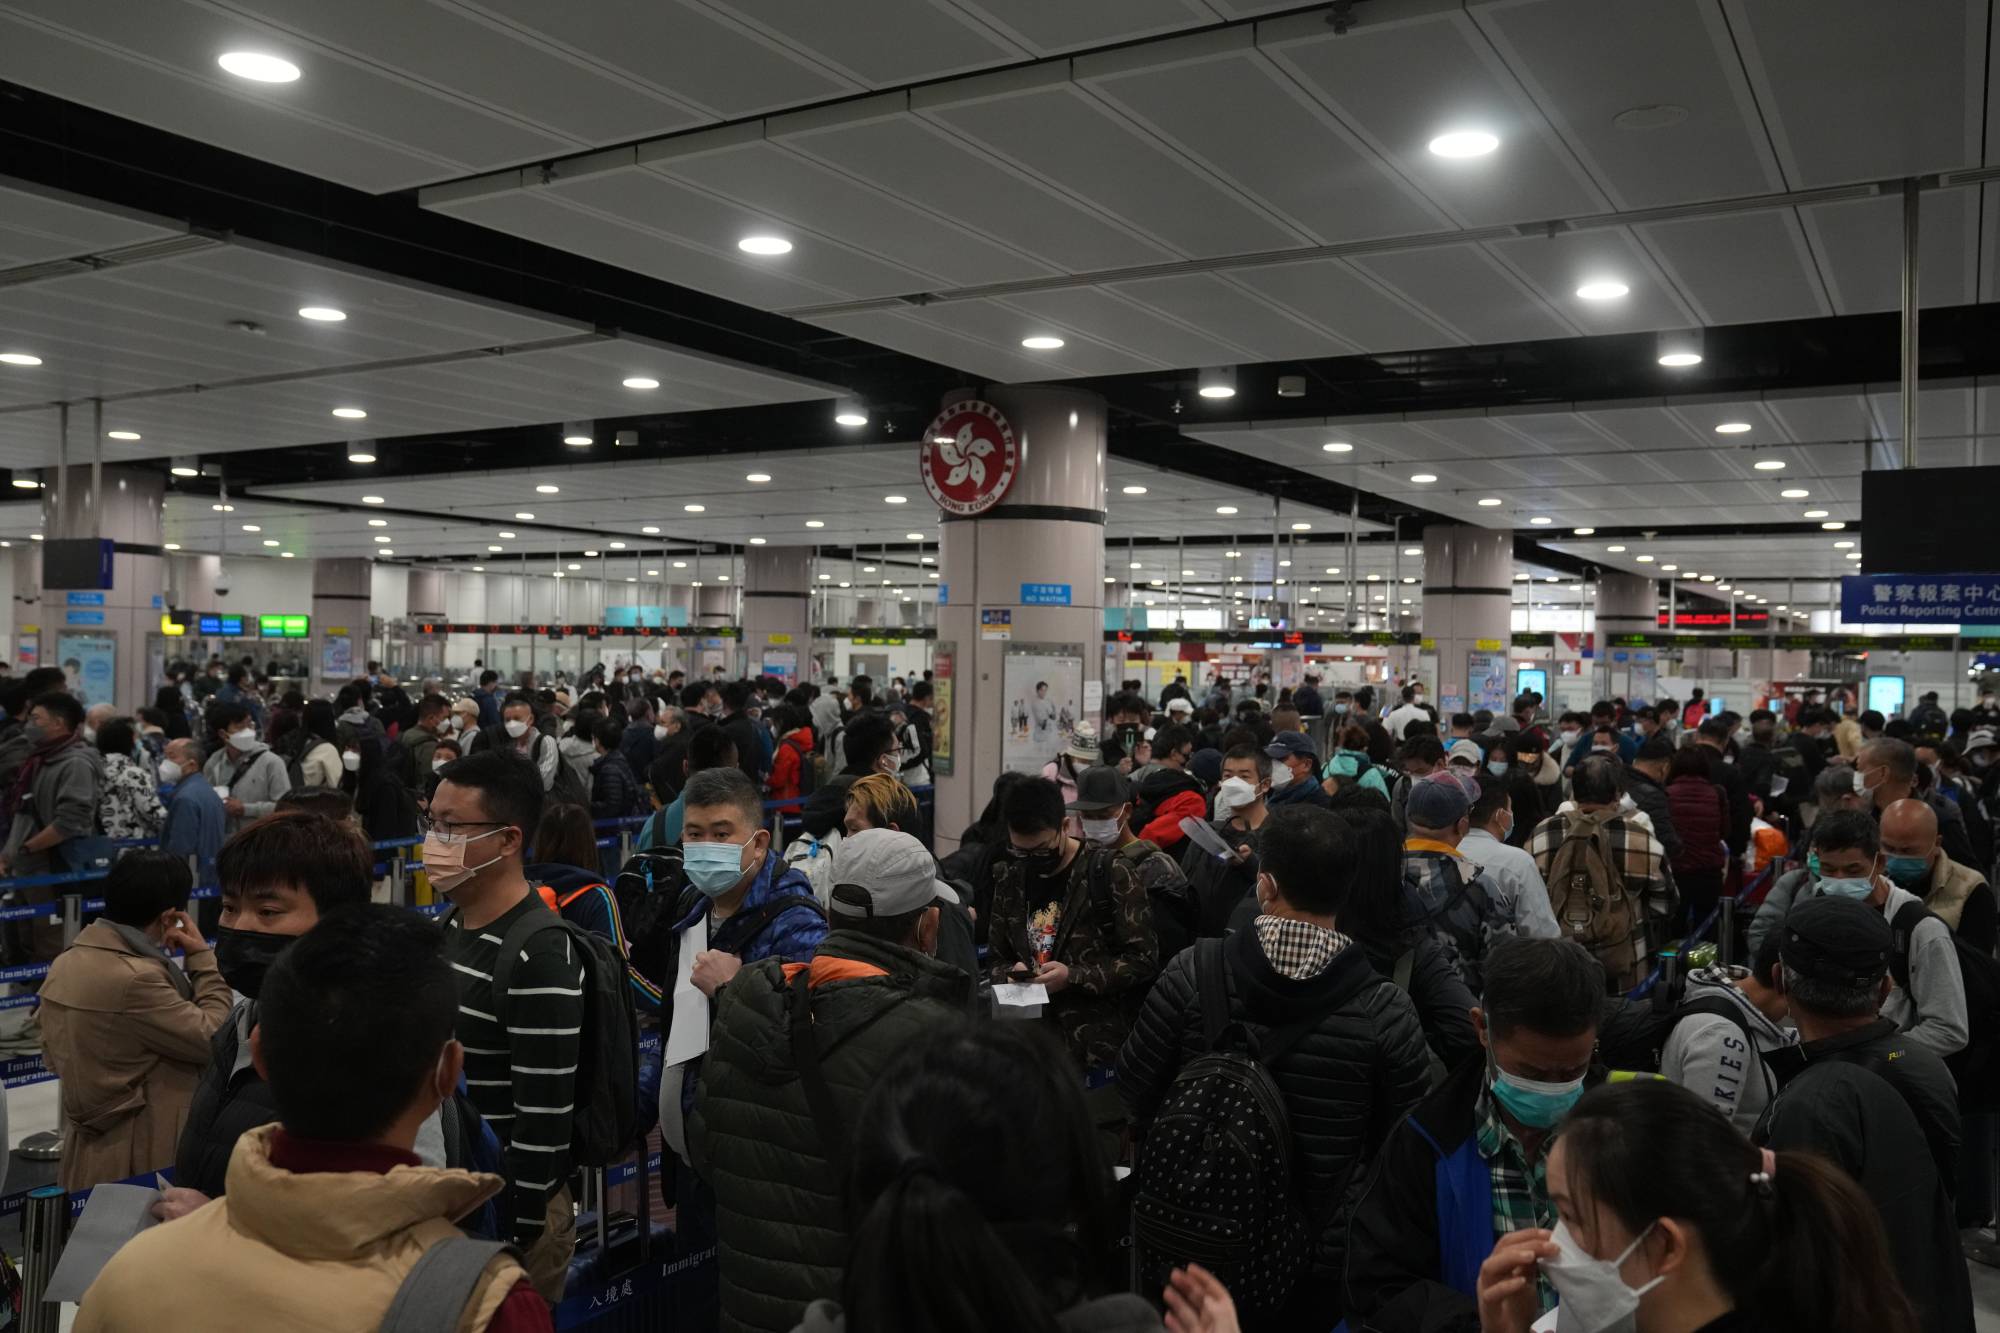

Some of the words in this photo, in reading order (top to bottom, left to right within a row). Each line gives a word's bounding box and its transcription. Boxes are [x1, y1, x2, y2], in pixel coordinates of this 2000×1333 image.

[938, 494, 965, 511] HONG
[968, 493, 996, 511] KONG
[1861, 604, 1897, 616] Police
[1899, 604, 1961, 619] Reporting
[1964, 604, 2000, 616] Centr
